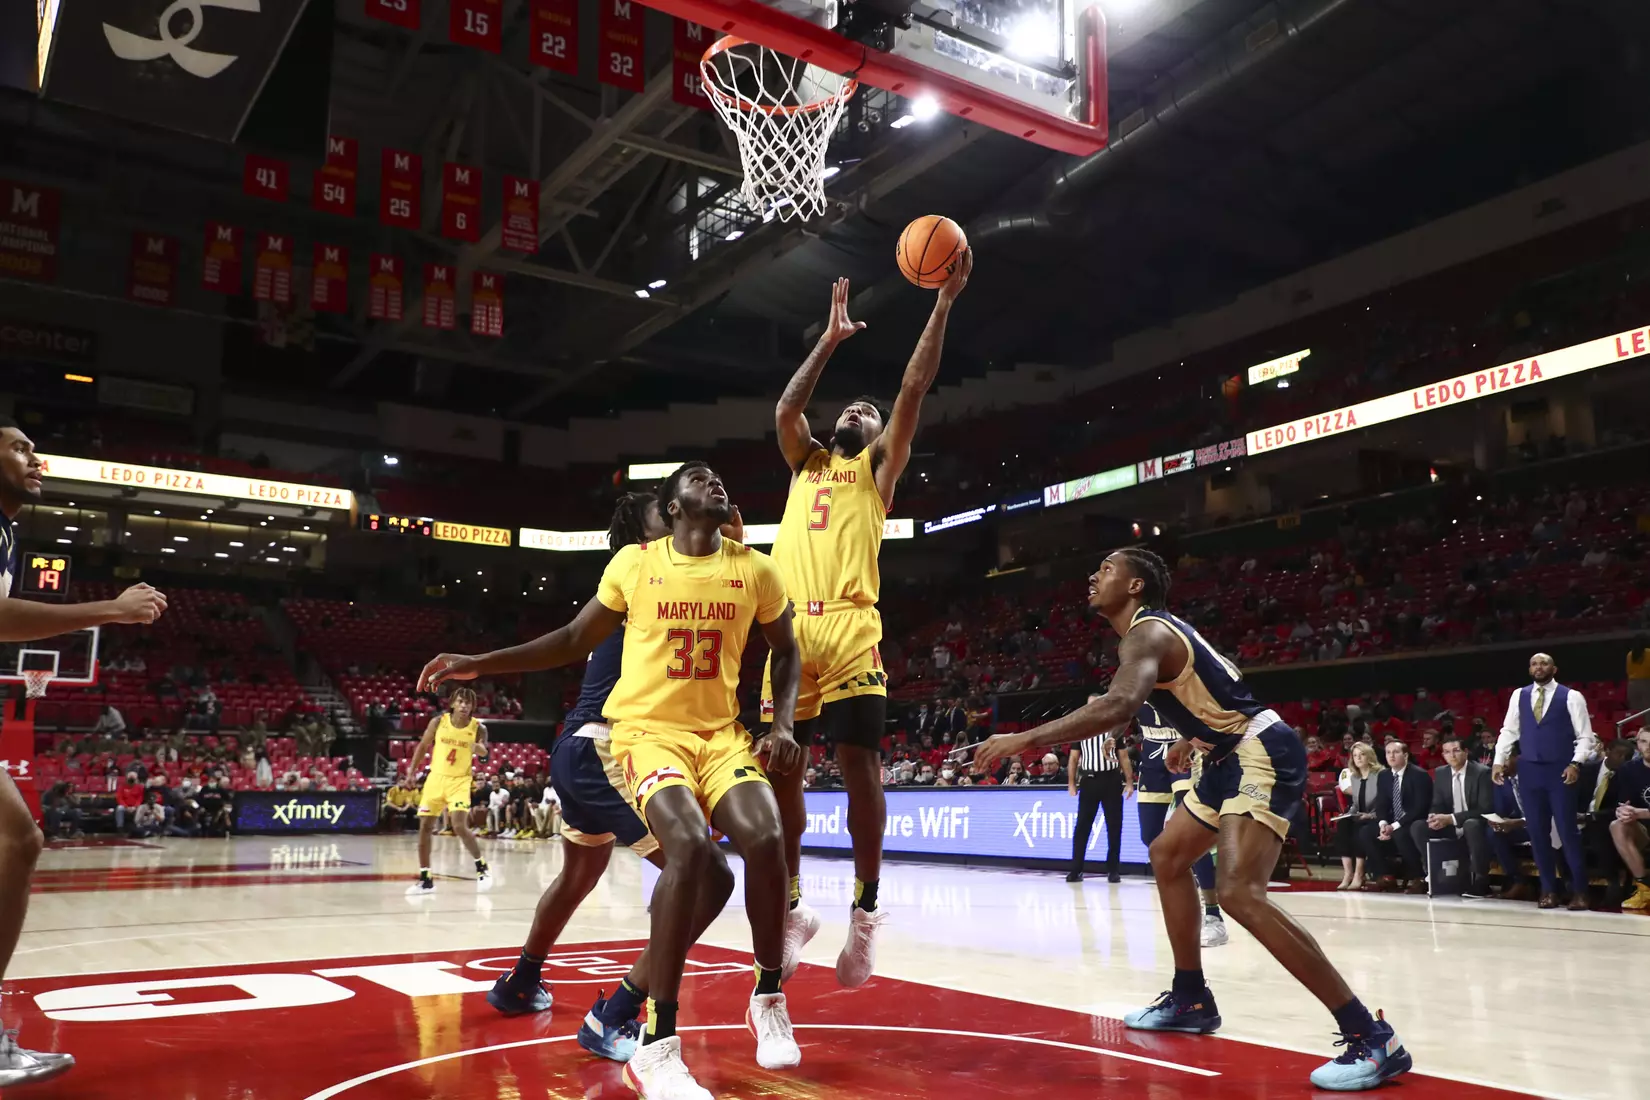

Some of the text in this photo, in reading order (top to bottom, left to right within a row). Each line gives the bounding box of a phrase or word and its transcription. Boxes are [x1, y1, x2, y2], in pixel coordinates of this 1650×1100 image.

[613, 0, 631, 20] M
[463, 8, 489, 36] 15
[687, 20, 702, 41] M
[541, 32, 567, 59] 22
[609, 51, 634, 78] 32
[329, 137, 346, 156] M
[394, 152, 410, 172] M
[255, 167, 278, 190] 41
[455, 167, 470, 185] M
[323, 183, 346, 205] 54
[514, 180, 529, 197] M
[11, 186, 41, 219] M
[389, 197, 411, 218] 25
[455, 212, 467, 230] 6
[217, 224, 232, 242] M
[147, 236, 165, 256] M
[268, 235, 283, 253] M
[324, 246, 340, 263] M
[379, 256, 394, 273] M
[433, 265, 447, 282] M
[482, 274, 495, 289] M
[0, 325, 91, 354] center
[1413, 359, 1543, 410] LEDO PIZZA
[1255, 409, 1357, 451] LEDO PIZZA
[99, 465, 206, 491] LEDO PIZZA
[805, 468, 857, 485] MAYLAND
[1143, 458, 1157, 479] M
[248, 482, 343, 506] LEDO PIZZA
[1049, 485, 1060, 503] M
[808, 487, 833, 531] 5
[434, 522, 511, 546] LEDO PIZZA
[532, 533, 605, 547] LEDO PIZZA
[38, 570, 60, 590] 19
[656, 601, 737, 621] MARYLAND
[809, 601, 821, 613] M
[666, 628, 723, 681] 33
[446, 748, 457, 767] 4
[272, 798, 346, 825] xfinity
[804, 805, 841, 834] and
[918, 806, 970, 840] WiFi
